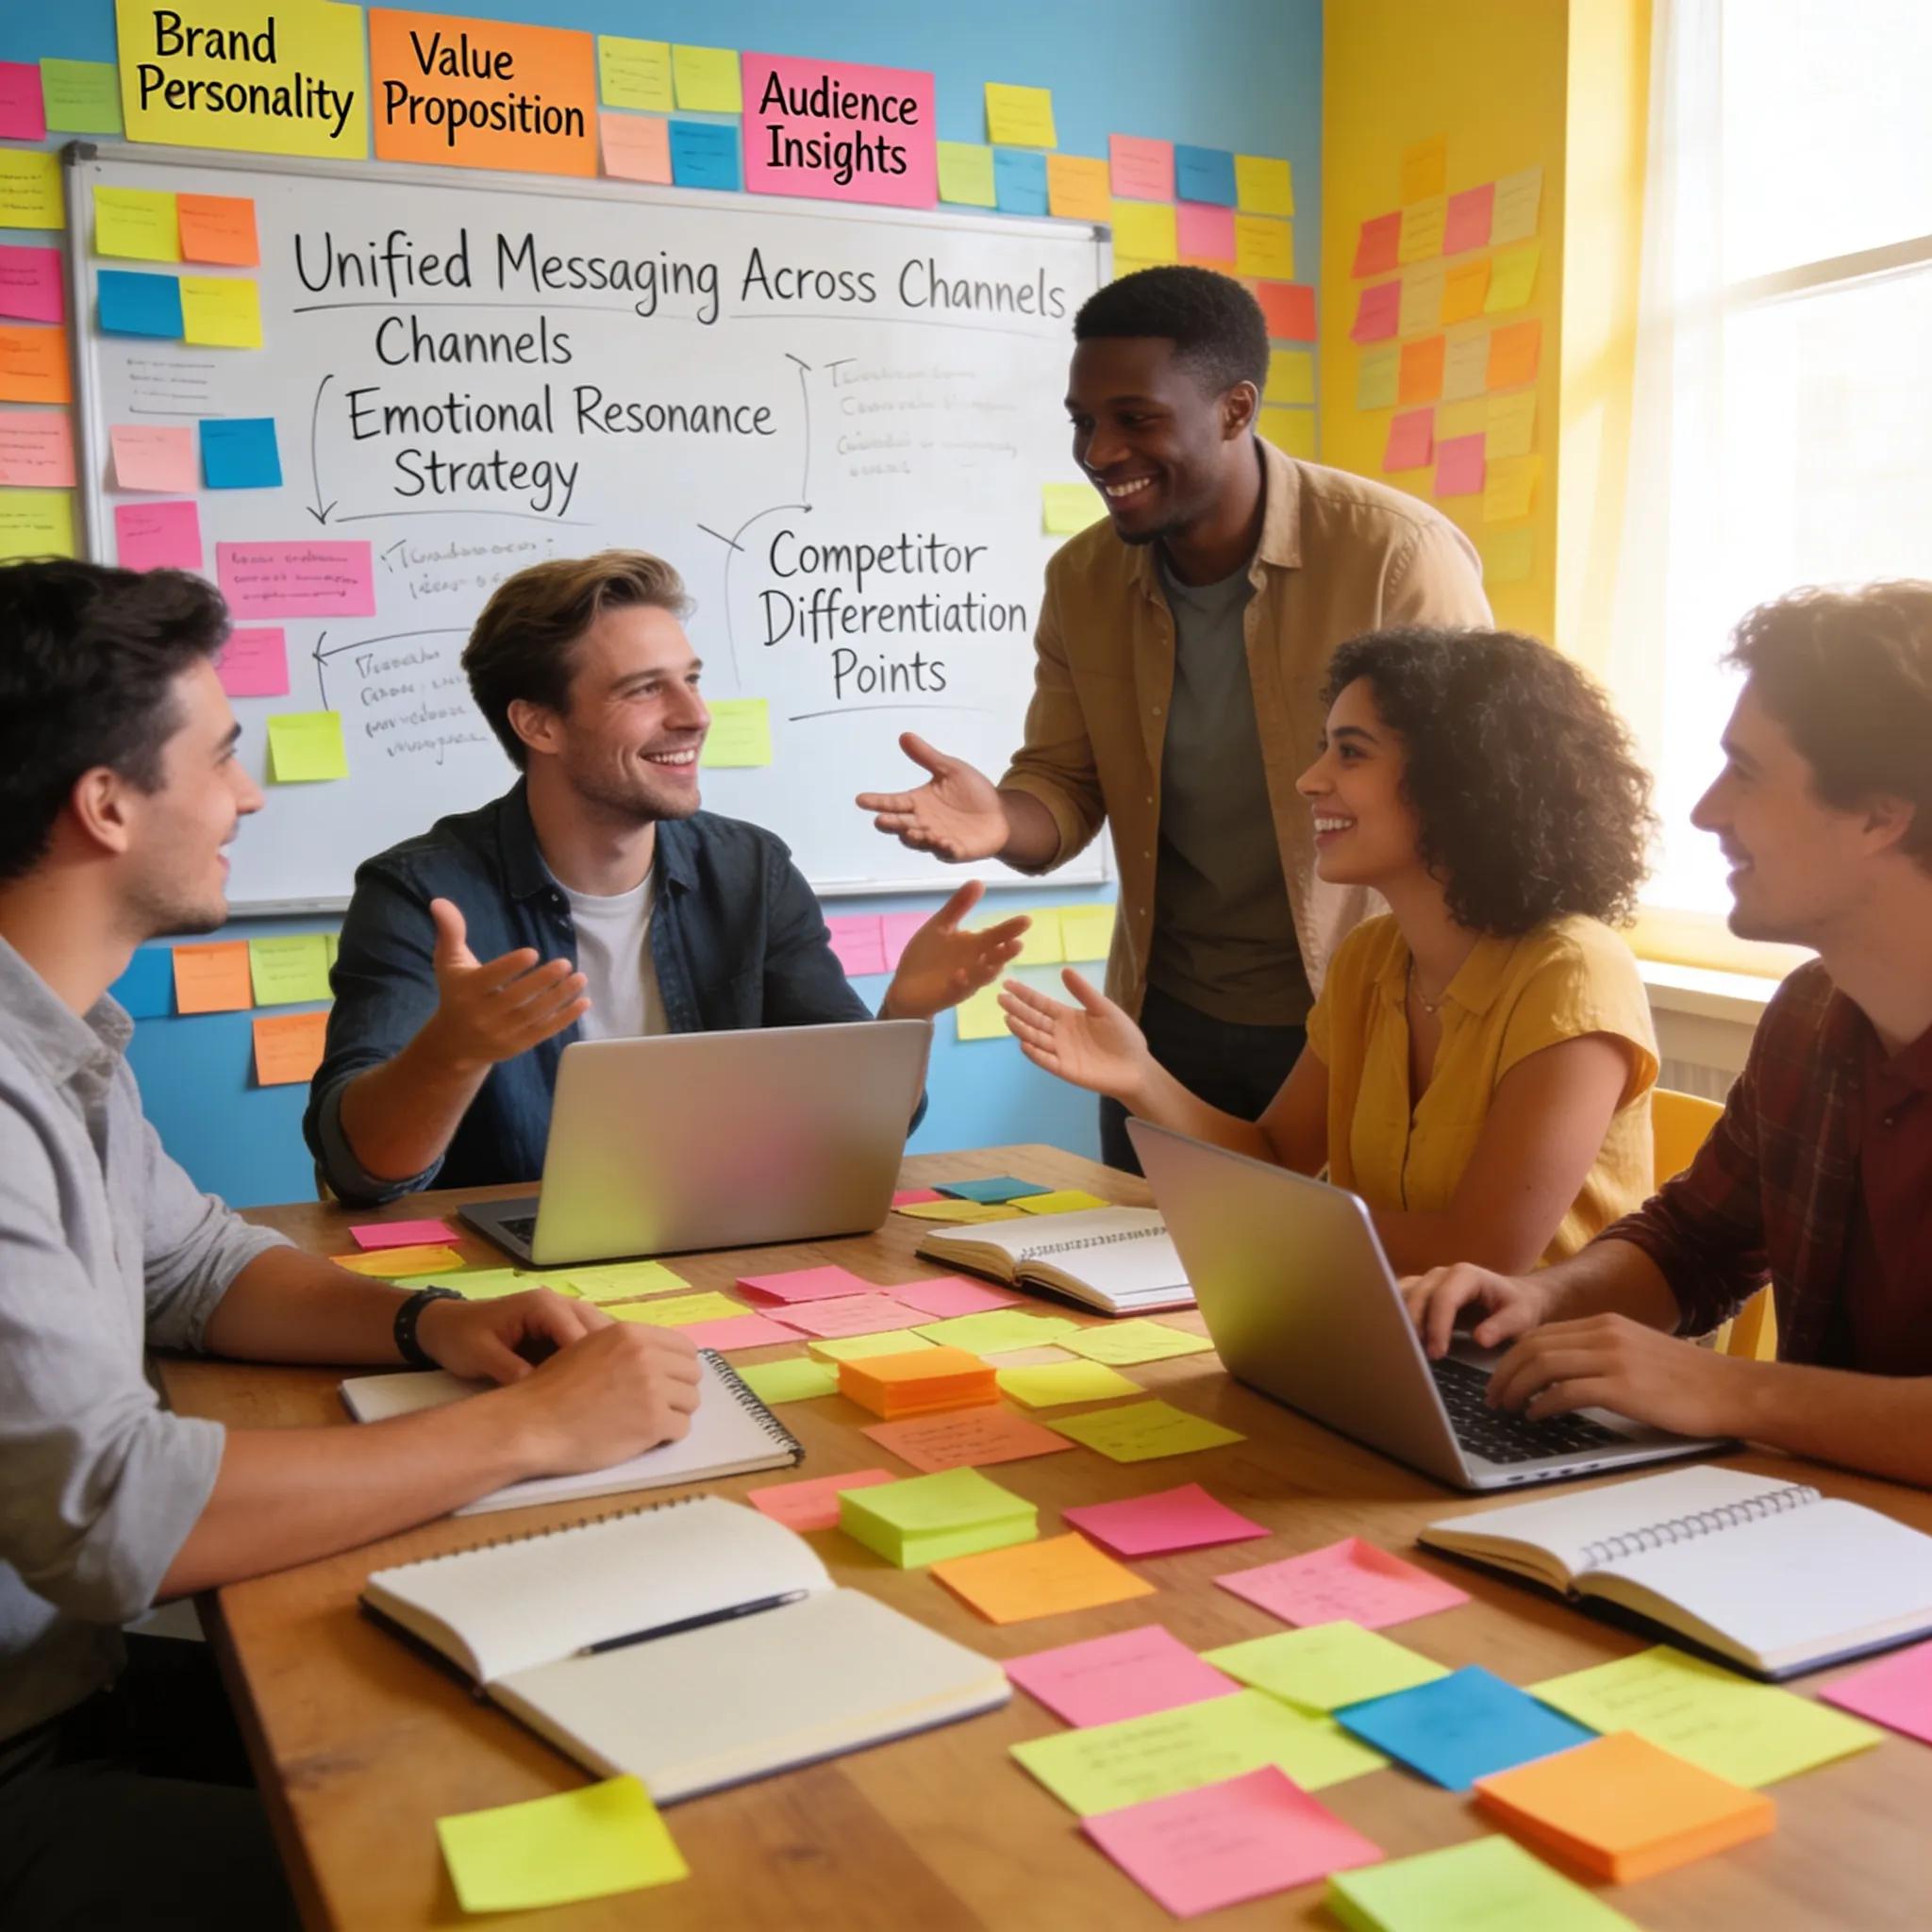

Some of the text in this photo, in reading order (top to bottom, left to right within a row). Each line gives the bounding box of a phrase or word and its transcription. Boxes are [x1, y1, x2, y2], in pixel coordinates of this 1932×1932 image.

[153, 10, 276, 64] Brand
[410, 31, 514, 80] Value
[137, 64, 355, 139] Personality
[383, 80, 584, 147] Proposition
[759, 71, 918, 125] Audience
[766, 125, 908, 186] Insights
[294, 227, 1066, 325] Unified Messaging Across Channels
[375, 314, 573, 366] Channels
[345, 382, 776, 441] Emotional Resonance
[393, 448, 578, 517] Strategy
[769, 528, 988, 592] Competitor
[758, 588, 1027, 647] Differentiation
[831, 647, 947, 700] Points
